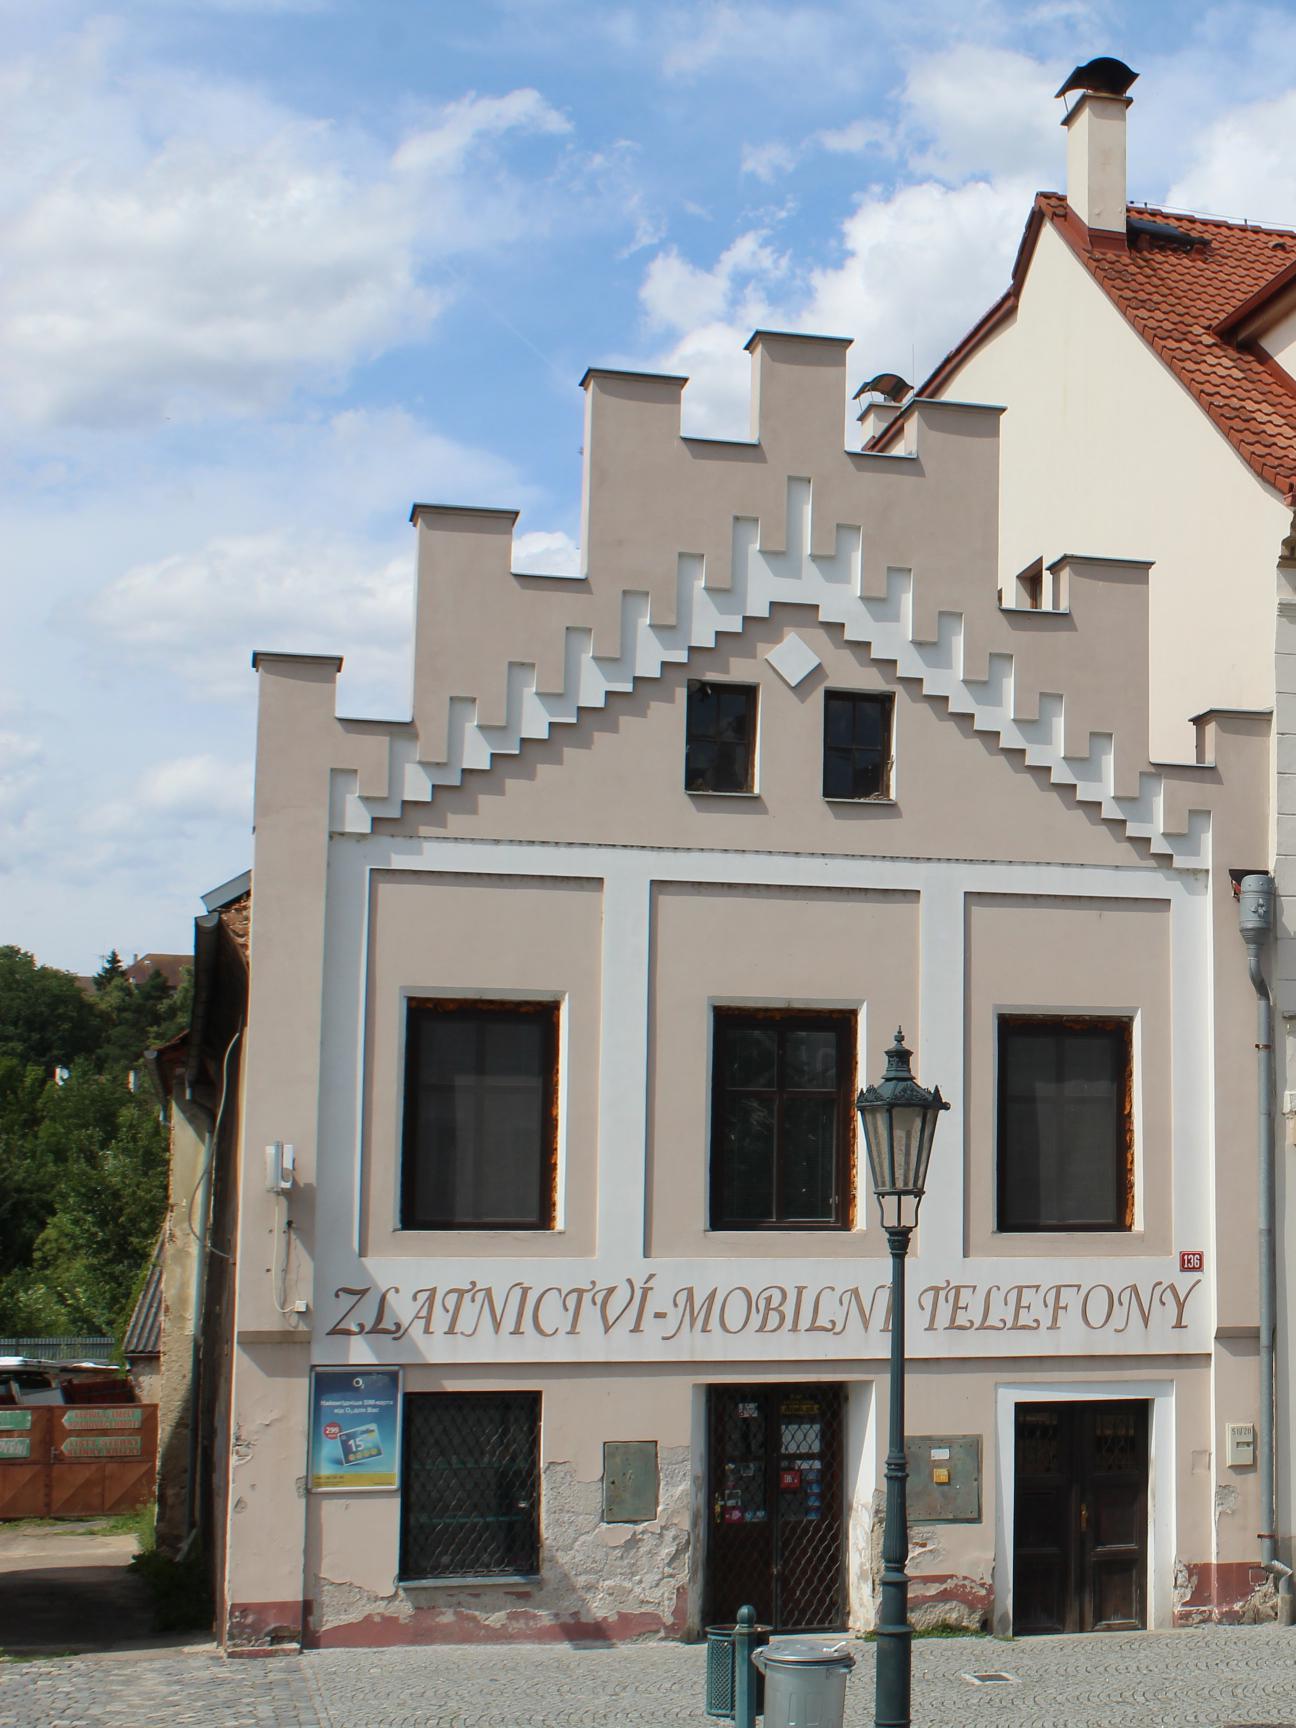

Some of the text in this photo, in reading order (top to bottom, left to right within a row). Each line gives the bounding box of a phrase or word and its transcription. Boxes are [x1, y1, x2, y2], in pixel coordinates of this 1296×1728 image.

[1183, 1254, 1201, 1269] 136
[917, 1278, 1203, 1333] TELEFONY
[347, 1437, 365, 1452] 15
